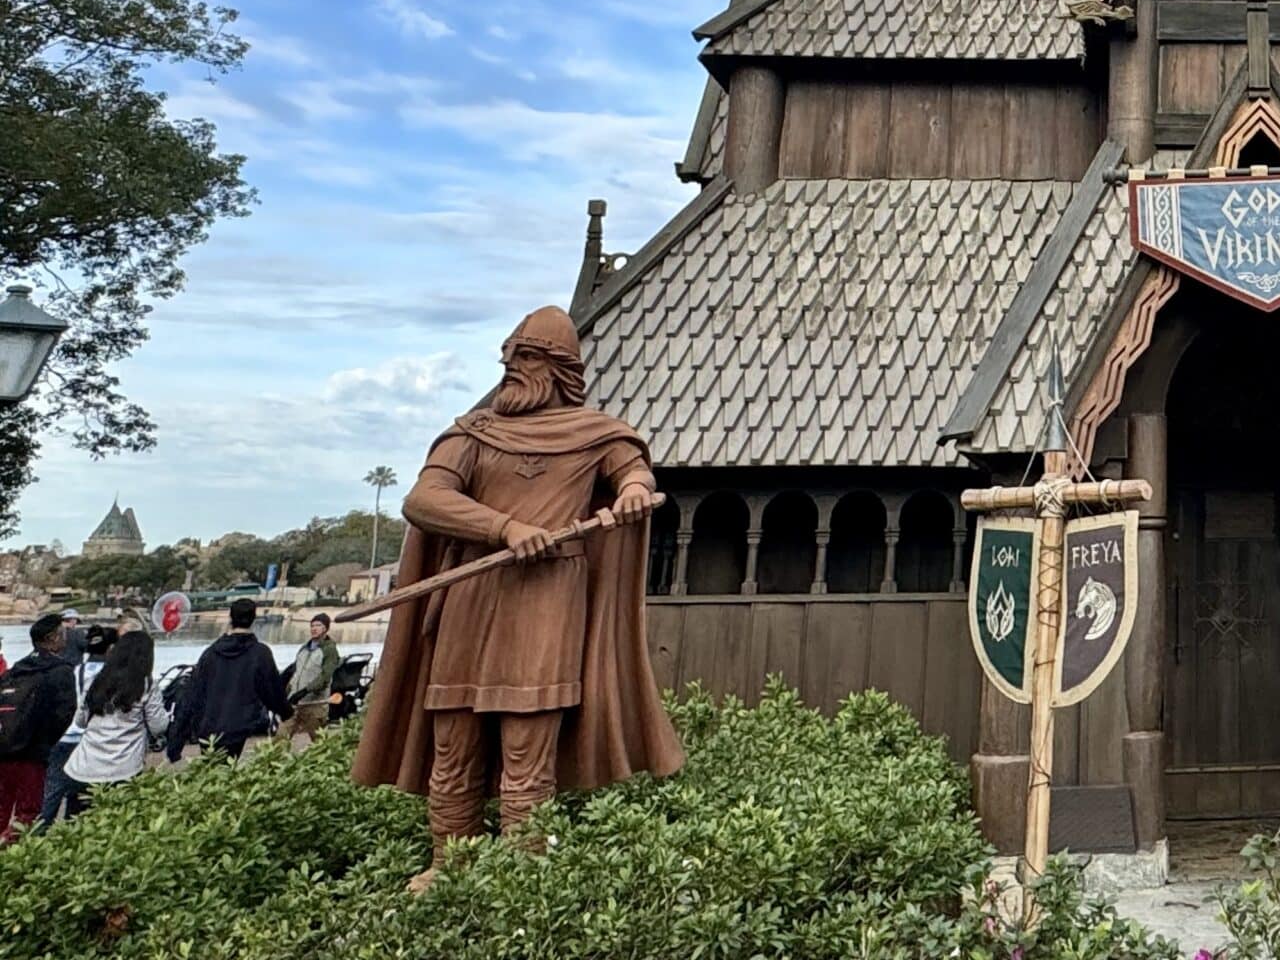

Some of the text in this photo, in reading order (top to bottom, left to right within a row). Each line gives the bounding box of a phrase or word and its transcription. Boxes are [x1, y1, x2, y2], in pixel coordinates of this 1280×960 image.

[1263, 217, 1280, 227] THE
[992, 545, 1020, 568] LOKI
[1071, 540, 1122, 569] FREYA
